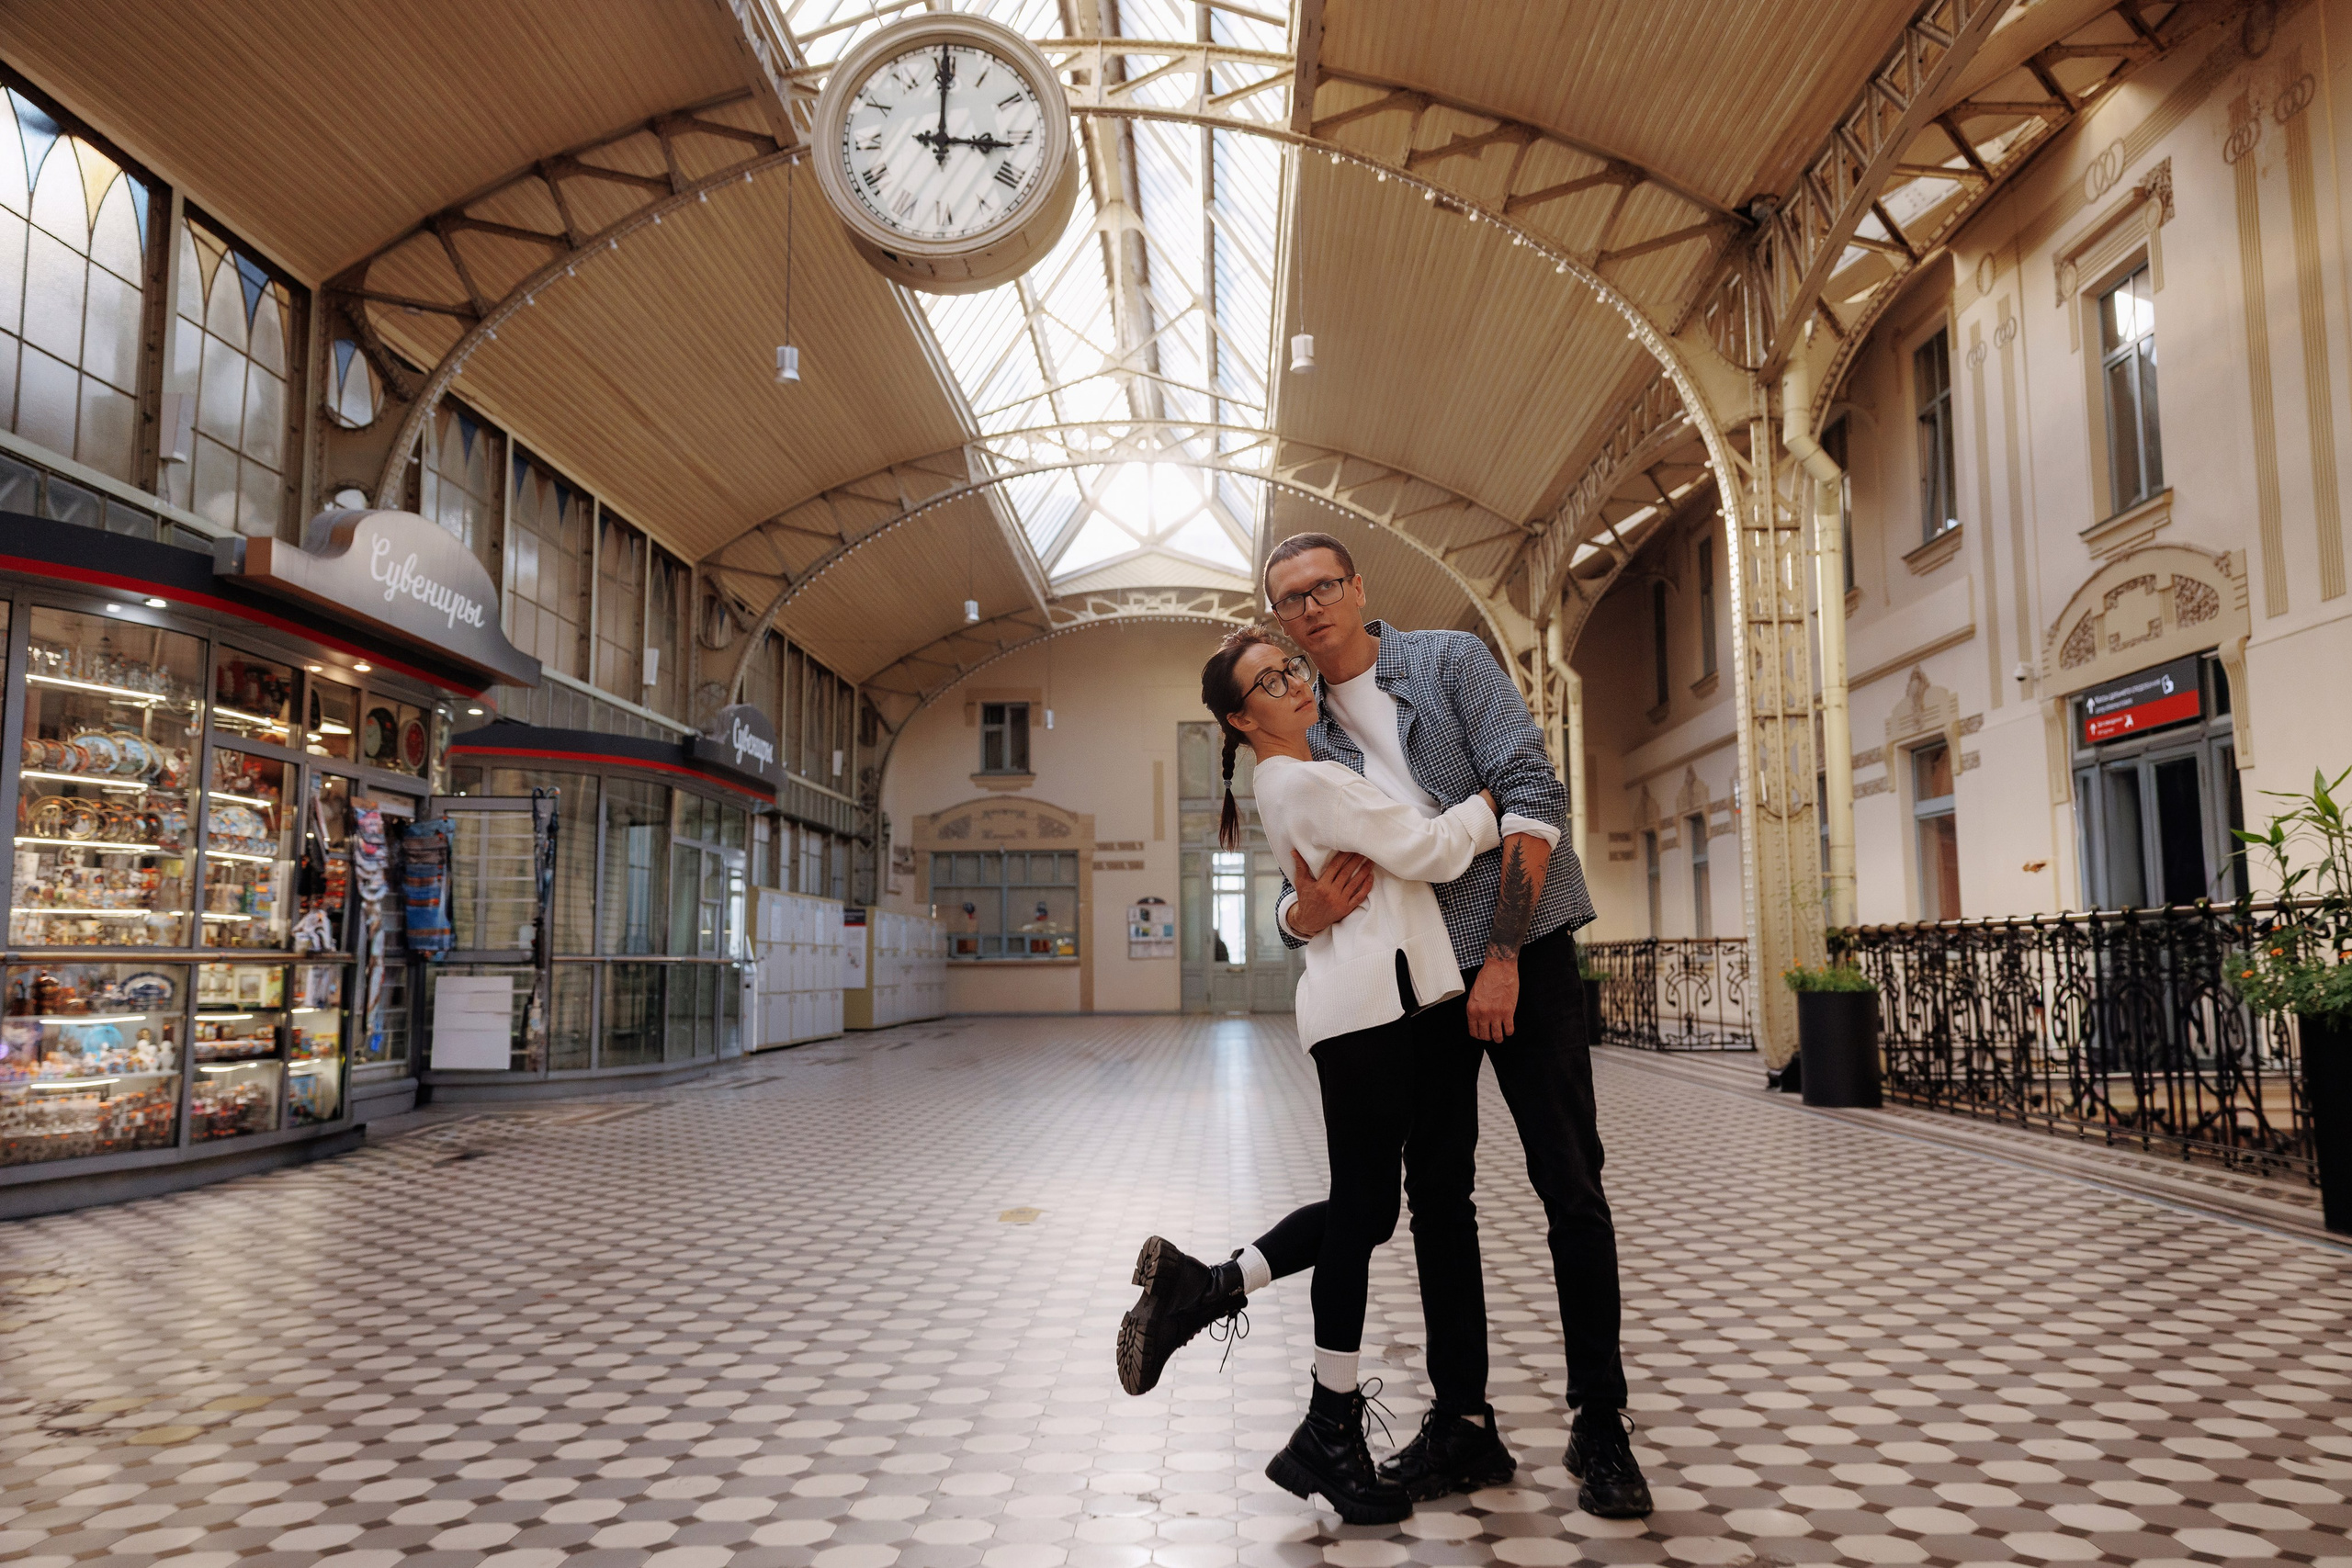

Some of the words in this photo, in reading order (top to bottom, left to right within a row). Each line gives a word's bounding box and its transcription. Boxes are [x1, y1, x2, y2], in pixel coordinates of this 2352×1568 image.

[866, 95, 891, 118] X
[997, 92, 1023, 111] II
[934, 200, 954, 226] VI
[370, 532, 485, 629] Сувениры
